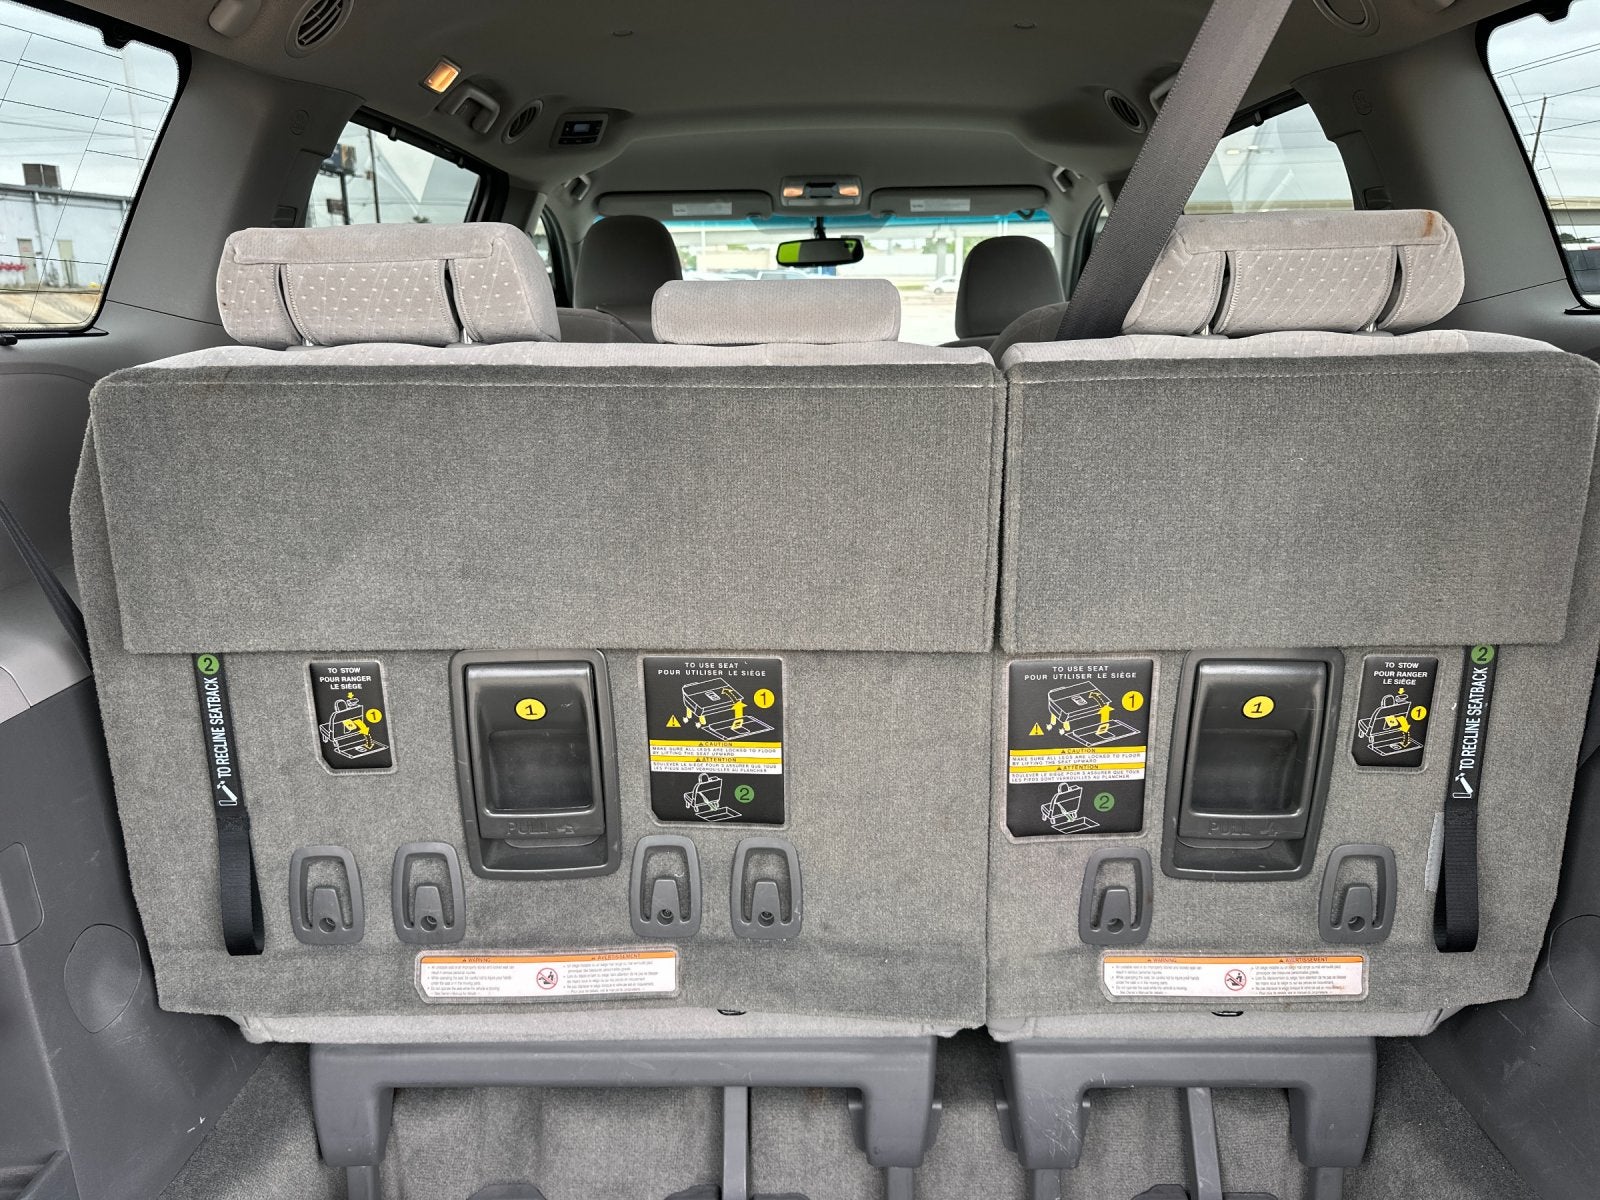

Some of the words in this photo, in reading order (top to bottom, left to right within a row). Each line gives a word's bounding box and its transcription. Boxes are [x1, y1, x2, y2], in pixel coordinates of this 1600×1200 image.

[1477, 646, 1488, 662] 2
[204, 657, 214, 672] 2
[1466, 667, 1488, 716] SEATBACK
[204, 677, 224, 725] SEATBACK
[760, 692, 766, 705] 1
[1129, 694, 1134, 708] 1
[525, 704, 538, 716] 1
[1251, 702, 1263, 714] 1
[1416, 708, 1421, 718] 1
[1461, 717, 1480, 756] RECLINE
[210, 726, 230, 764] RECLINE
[1459, 758, 1474, 770] TO
[218, 766, 232, 778] TO
[740, 788, 750, 800] 2
[1100, 795, 1110, 808] 2
[507, 822, 549, 834] PULL
[1208, 822, 1251, 836] PULL
